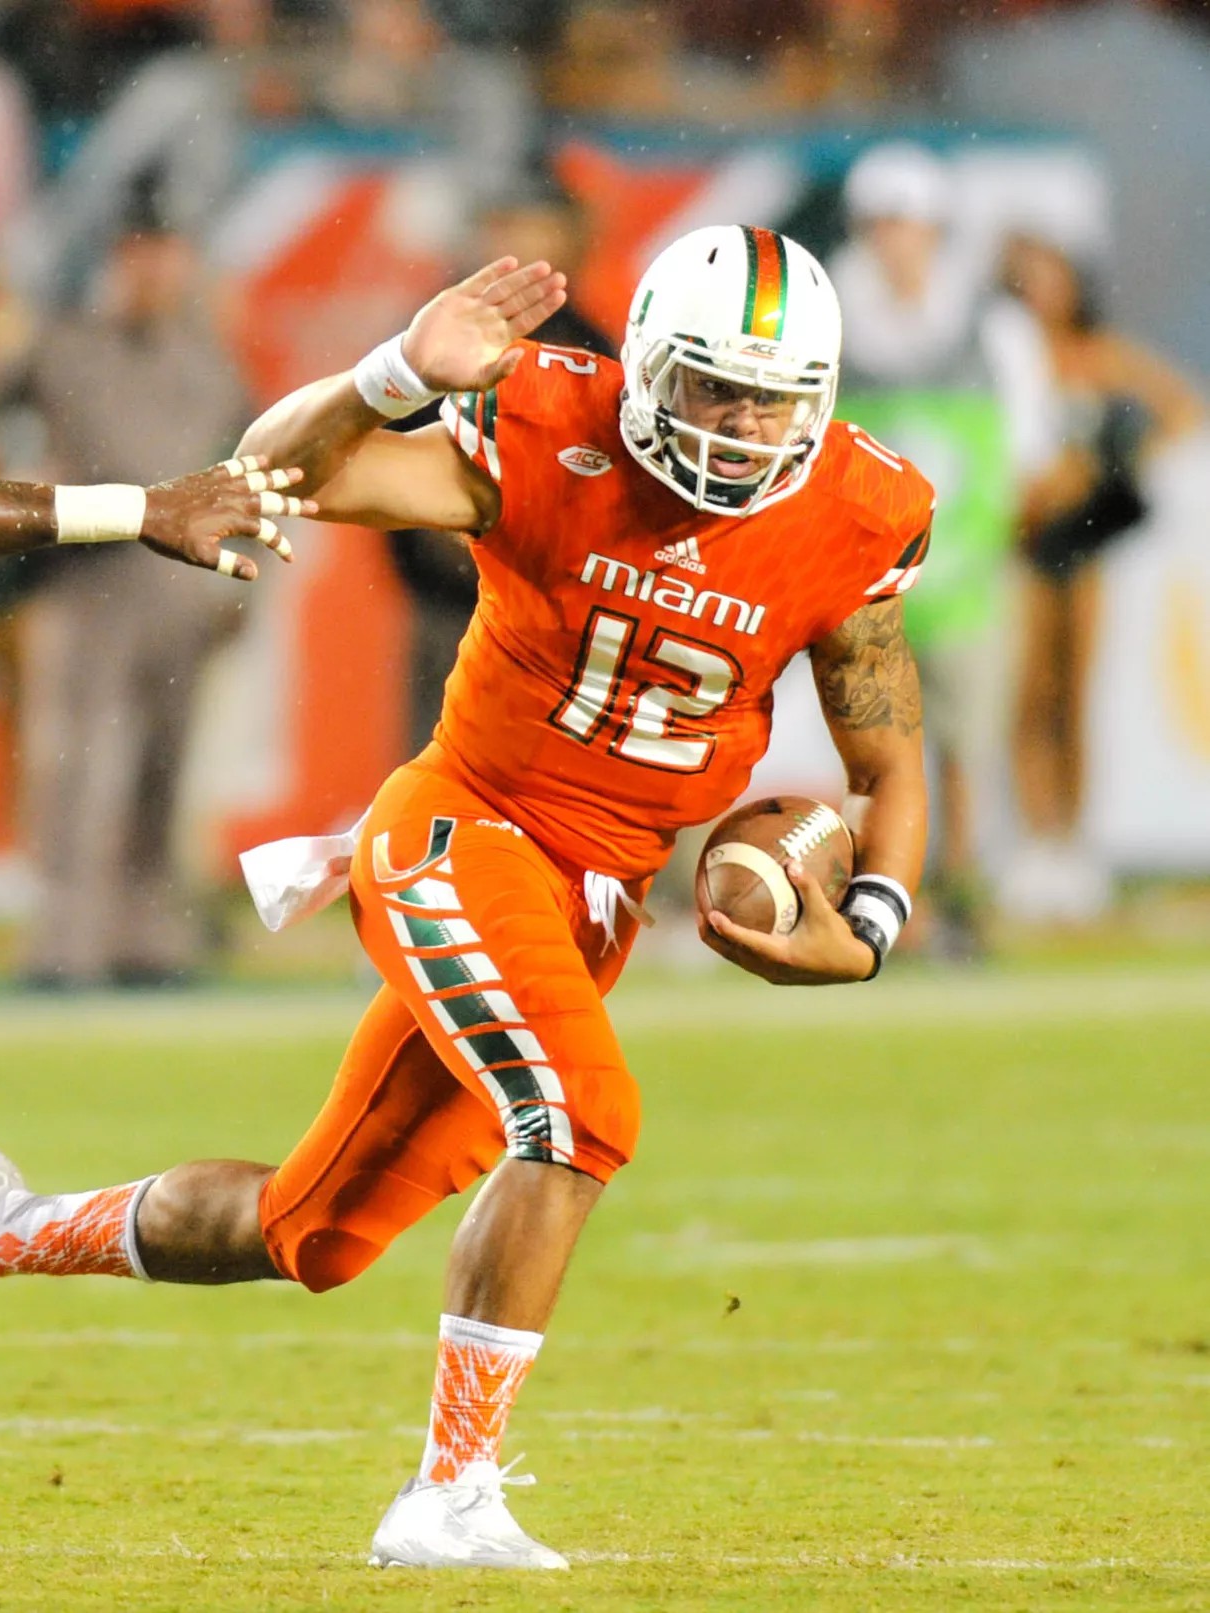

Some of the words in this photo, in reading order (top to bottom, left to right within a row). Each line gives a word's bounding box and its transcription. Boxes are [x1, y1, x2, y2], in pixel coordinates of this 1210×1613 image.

[742, 343, 779, 359] ACC
[565, 451, 607, 469] ACC
[653, 550, 707, 575] adidas
[547, 605, 744, 775] 12
